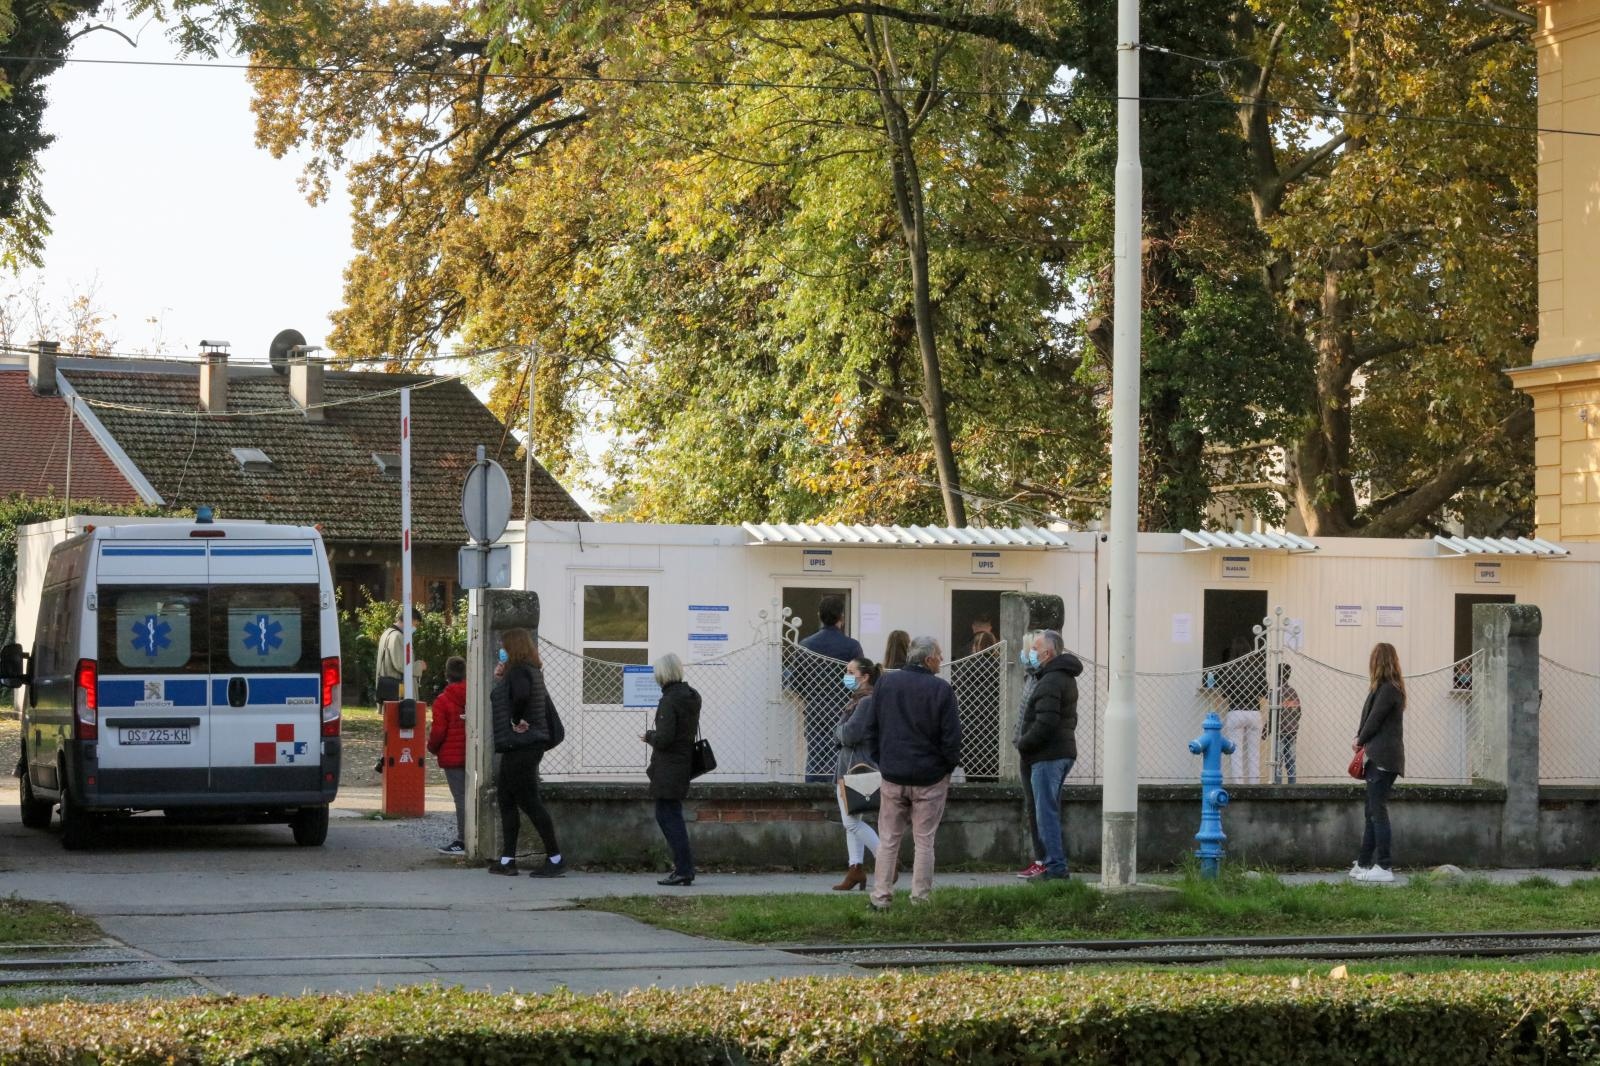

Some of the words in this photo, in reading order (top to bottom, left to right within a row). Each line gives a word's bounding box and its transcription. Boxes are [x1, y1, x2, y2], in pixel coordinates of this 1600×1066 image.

[810, 558, 826, 566] UPIS
[979, 560, 994, 568] UPIS
[1480, 570, 1495, 578] UPIS
[127, 729, 141, 741] OS
